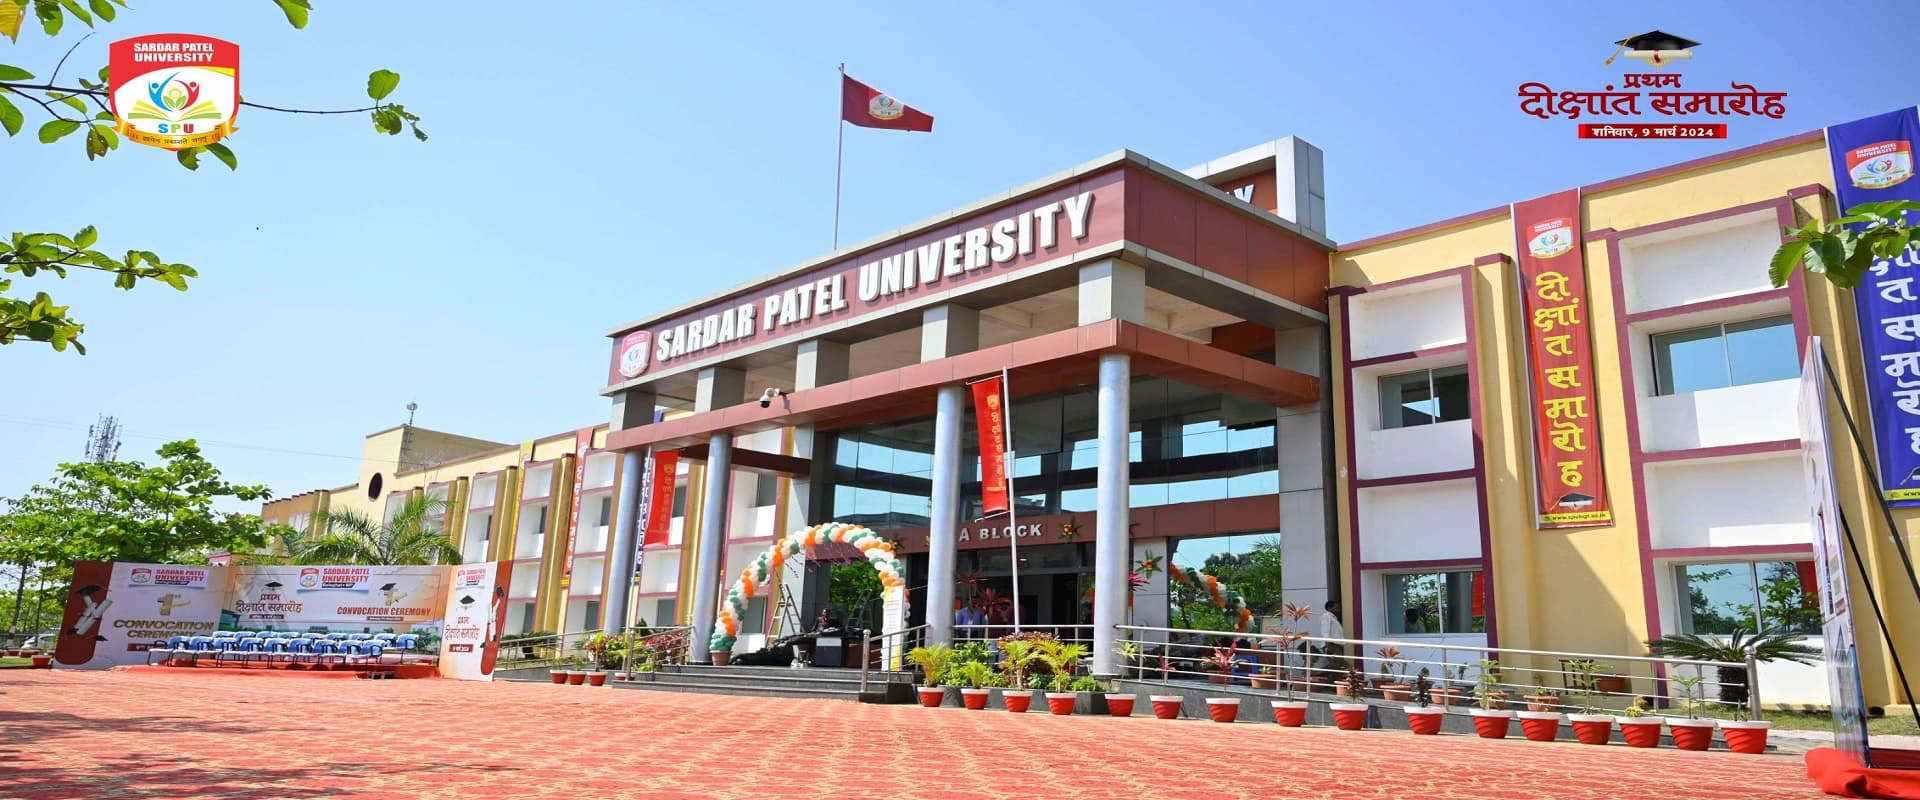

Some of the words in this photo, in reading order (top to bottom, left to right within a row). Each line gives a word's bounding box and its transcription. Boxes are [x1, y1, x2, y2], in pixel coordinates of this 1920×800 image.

[656, 303, 757, 361] SARDAR
[763, 273, 848, 331] PATEL
[858, 191, 1096, 302] UNIVERSITY
[959, 528, 970, 542] A
[979, 523, 1042, 540] BLOCK
[322, 575, 369, 583] UNIVERSITY
[337, 607, 389, 616] CONVOCATION
[390, 607, 431, 616] CEREMONY
[113, 619, 215, 631] CONVOCATION
